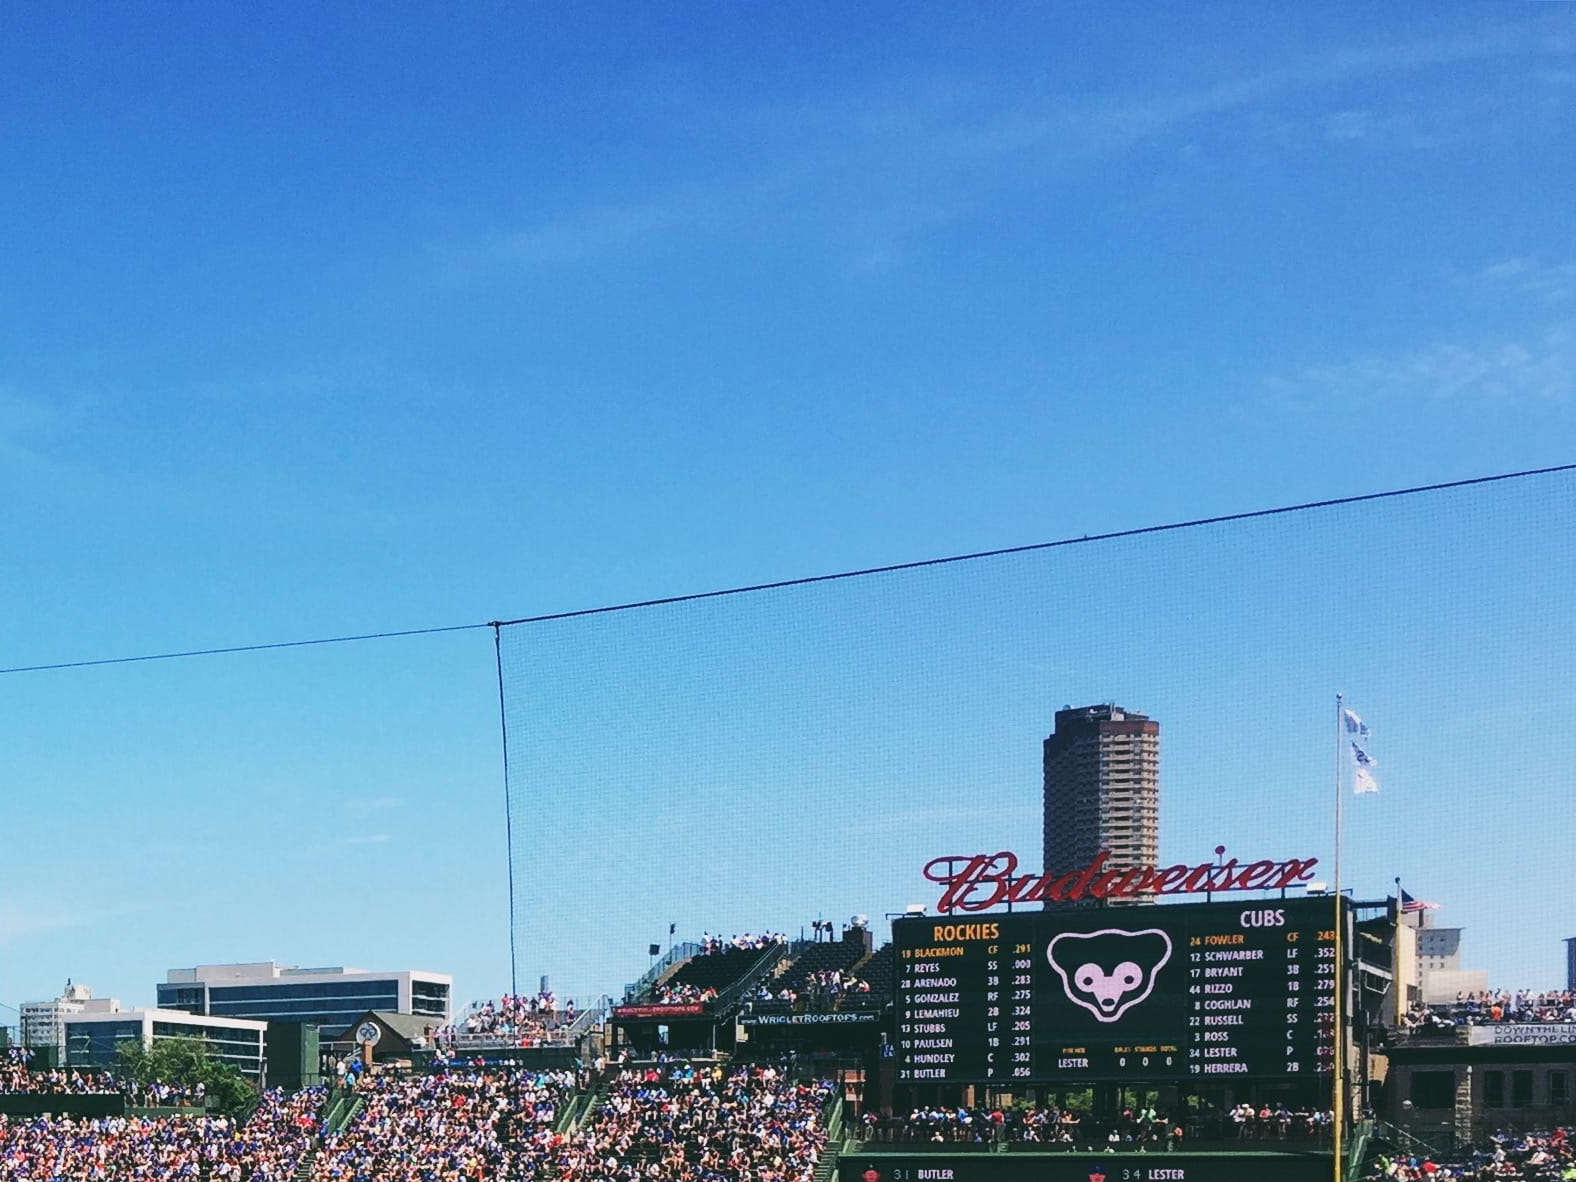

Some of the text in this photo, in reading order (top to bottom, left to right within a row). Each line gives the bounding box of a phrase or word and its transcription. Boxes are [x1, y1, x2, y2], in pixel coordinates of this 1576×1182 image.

[923, 846, 1319, 914] Budweiser
[1240, 909, 1285, 928] CUBS
[934, 923, 1000, 941] ROCKIES
[1204, 934, 1244, 945] FOWLER
[1286, 932, 1299, 942] CF
[914, 946, 964, 958] BLACKMON
[987, 945, 999, 954] CF
[1190, 947, 1336, 962] 12 SCHWARBER LF .352
[905, 964, 910, 974] 7
[914, 962, 940, 973] REYES
[987, 960, 998, 971] SS
[1189, 963, 1335, 978] 17 BRYANT 3B .251
[913, 977, 957, 988] ARENADO
[987, 975, 999, 986] 3B
[1189, 979, 1336, 995] 44 RIZZO 1B .279
[905, 989, 1031, 1004] 5 GONZALEZ RF .275
[1204, 999, 1252, 1010] COGHLAN
[1286, 997, 1299, 1008] RF
[1314, 996, 1335, 1007] .254
[905, 1005, 1031, 1019] 9 LEMAHIEU 2B .324
[1189, 1016, 1200, 1026] 22
[1204, 1014, 1244, 1026] RUSSELL
[1286, 1013, 1298, 1024] SS
[900, 1020, 1031, 1034] 13 STUBBS LF .205
[1194, 1029, 1292, 1042] 3 ROSS C
[900, 1039, 911, 1049] 10
[914, 1038, 953, 1049] PAULSEN
[988, 1037, 1000, 1047] 1B
[904, 1052, 1031, 1064] 4 HUNDLEY C .302
[1189, 1048, 1201, 1058] 34
[1204, 1047, 1238, 1058] LESTER
[1286, 1046, 1293, 1056] P
[1058, 1058, 1089, 1068] LESTER
[1119, 1057, 1126, 1067] 0
[1142, 1056, 1149, 1066] 0
[1204, 1062, 1248, 1074] HERRERA
[1286, 1062, 1299, 1072] 2B
[900, 1069, 910, 1079] 31
[913, 1068, 946, 1079] BUTLER
[987, 1067, 993, 1078] P
[918, 1169, 954, 1180] BUTLER
[1123, 1169, 1185, 1180] 34 LESTER
